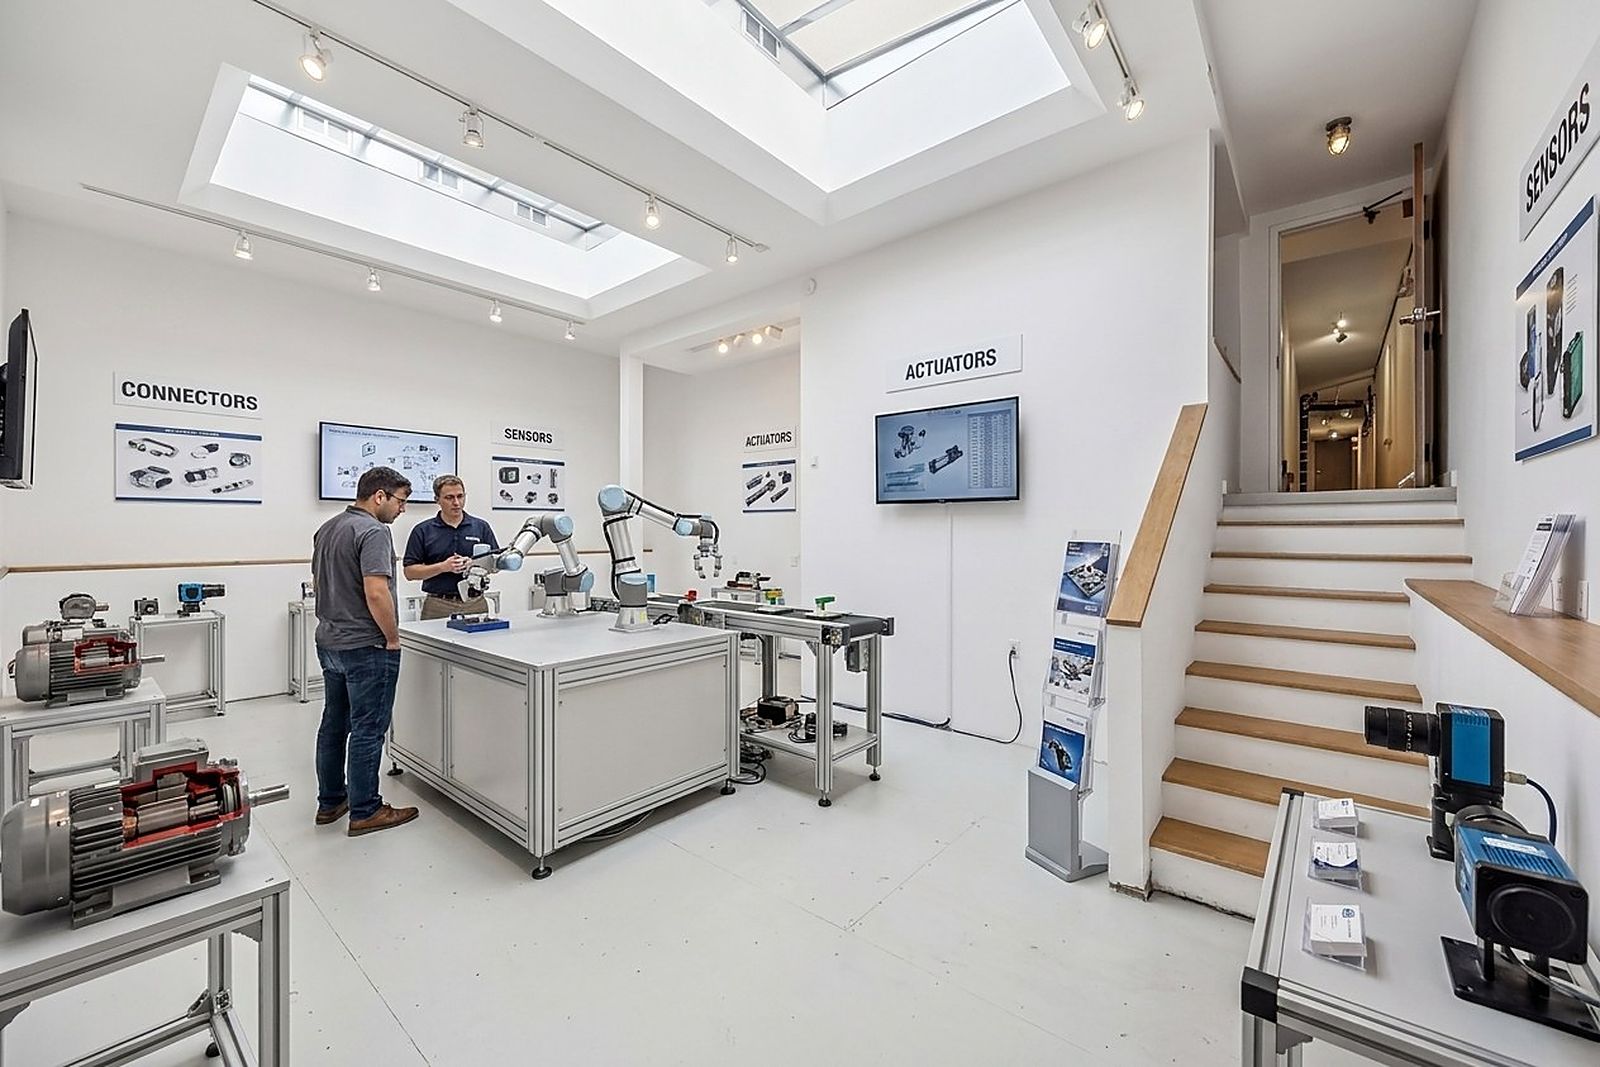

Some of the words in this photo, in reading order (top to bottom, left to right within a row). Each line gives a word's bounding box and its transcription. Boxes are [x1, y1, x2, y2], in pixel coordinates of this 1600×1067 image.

[1526, 82, 1590, 213] SENSORS
[905, 348, 997, 381] ACTUATORS
[121, 381, 258, 410] CONNECTORS
[504, 428, 553, 444] SENSORS
[745, 431, 792, 447] ACTUATORS
